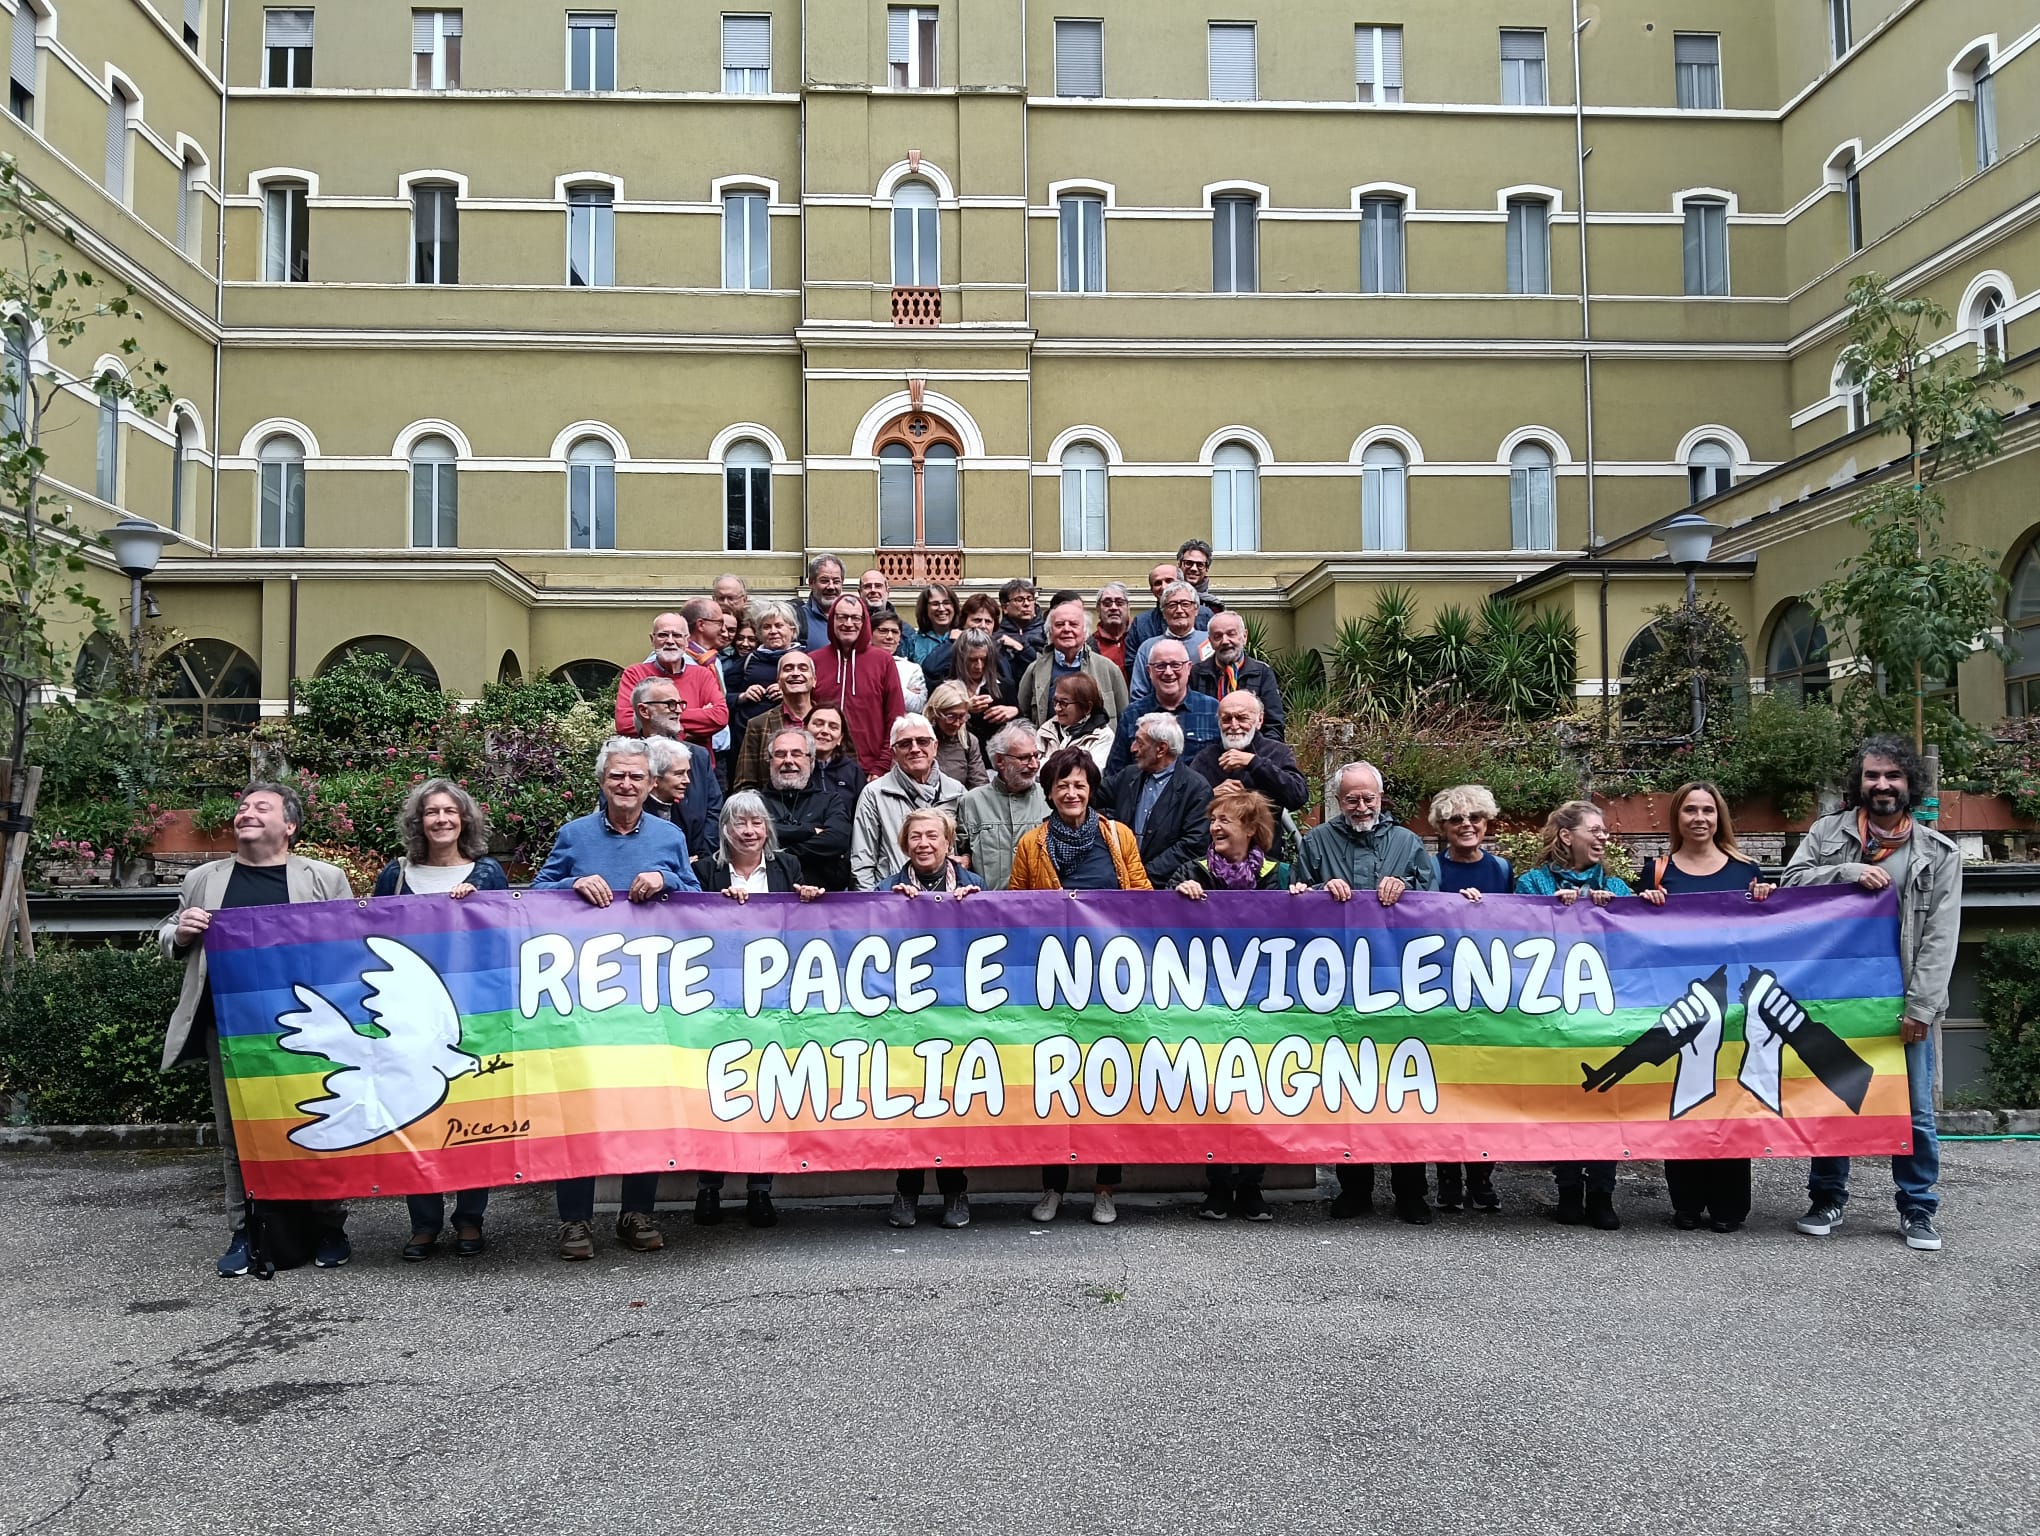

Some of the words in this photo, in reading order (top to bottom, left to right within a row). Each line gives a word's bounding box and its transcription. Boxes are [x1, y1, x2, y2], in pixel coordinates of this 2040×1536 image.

[519, 932, 715, 1019] RETE
[743, 934, 938, 1017] PACE
[964, 934, 1009, 1013] E
[1035, 935, 1615, 1016] NONVIOLENZA
[706, 1036, 1005, 1123] EMILIA
[1033, 1035, 1439, 1119] ROMAGNA
[441, 1117, 531, 1150] Picasso
